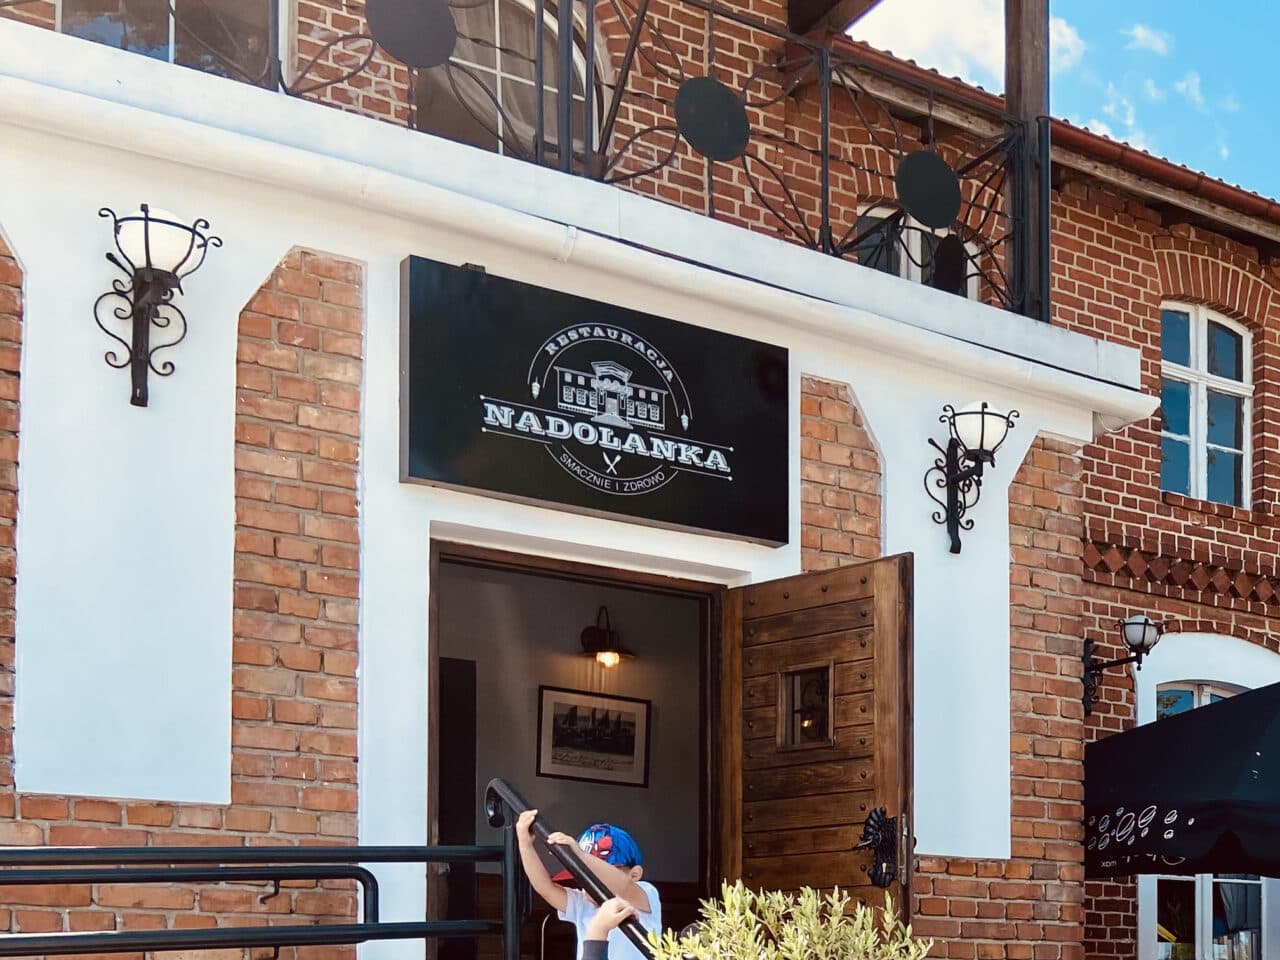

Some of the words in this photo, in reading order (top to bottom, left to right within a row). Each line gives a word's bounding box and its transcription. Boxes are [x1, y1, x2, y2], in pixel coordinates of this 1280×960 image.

[545, 326, 674, 382] RESTAURACJA
[482, 402, 731, 473] NADOLANKA
[560, 453, 611, 489] SMACZNIE
[623, 471, 665, 492] ZDROWO
